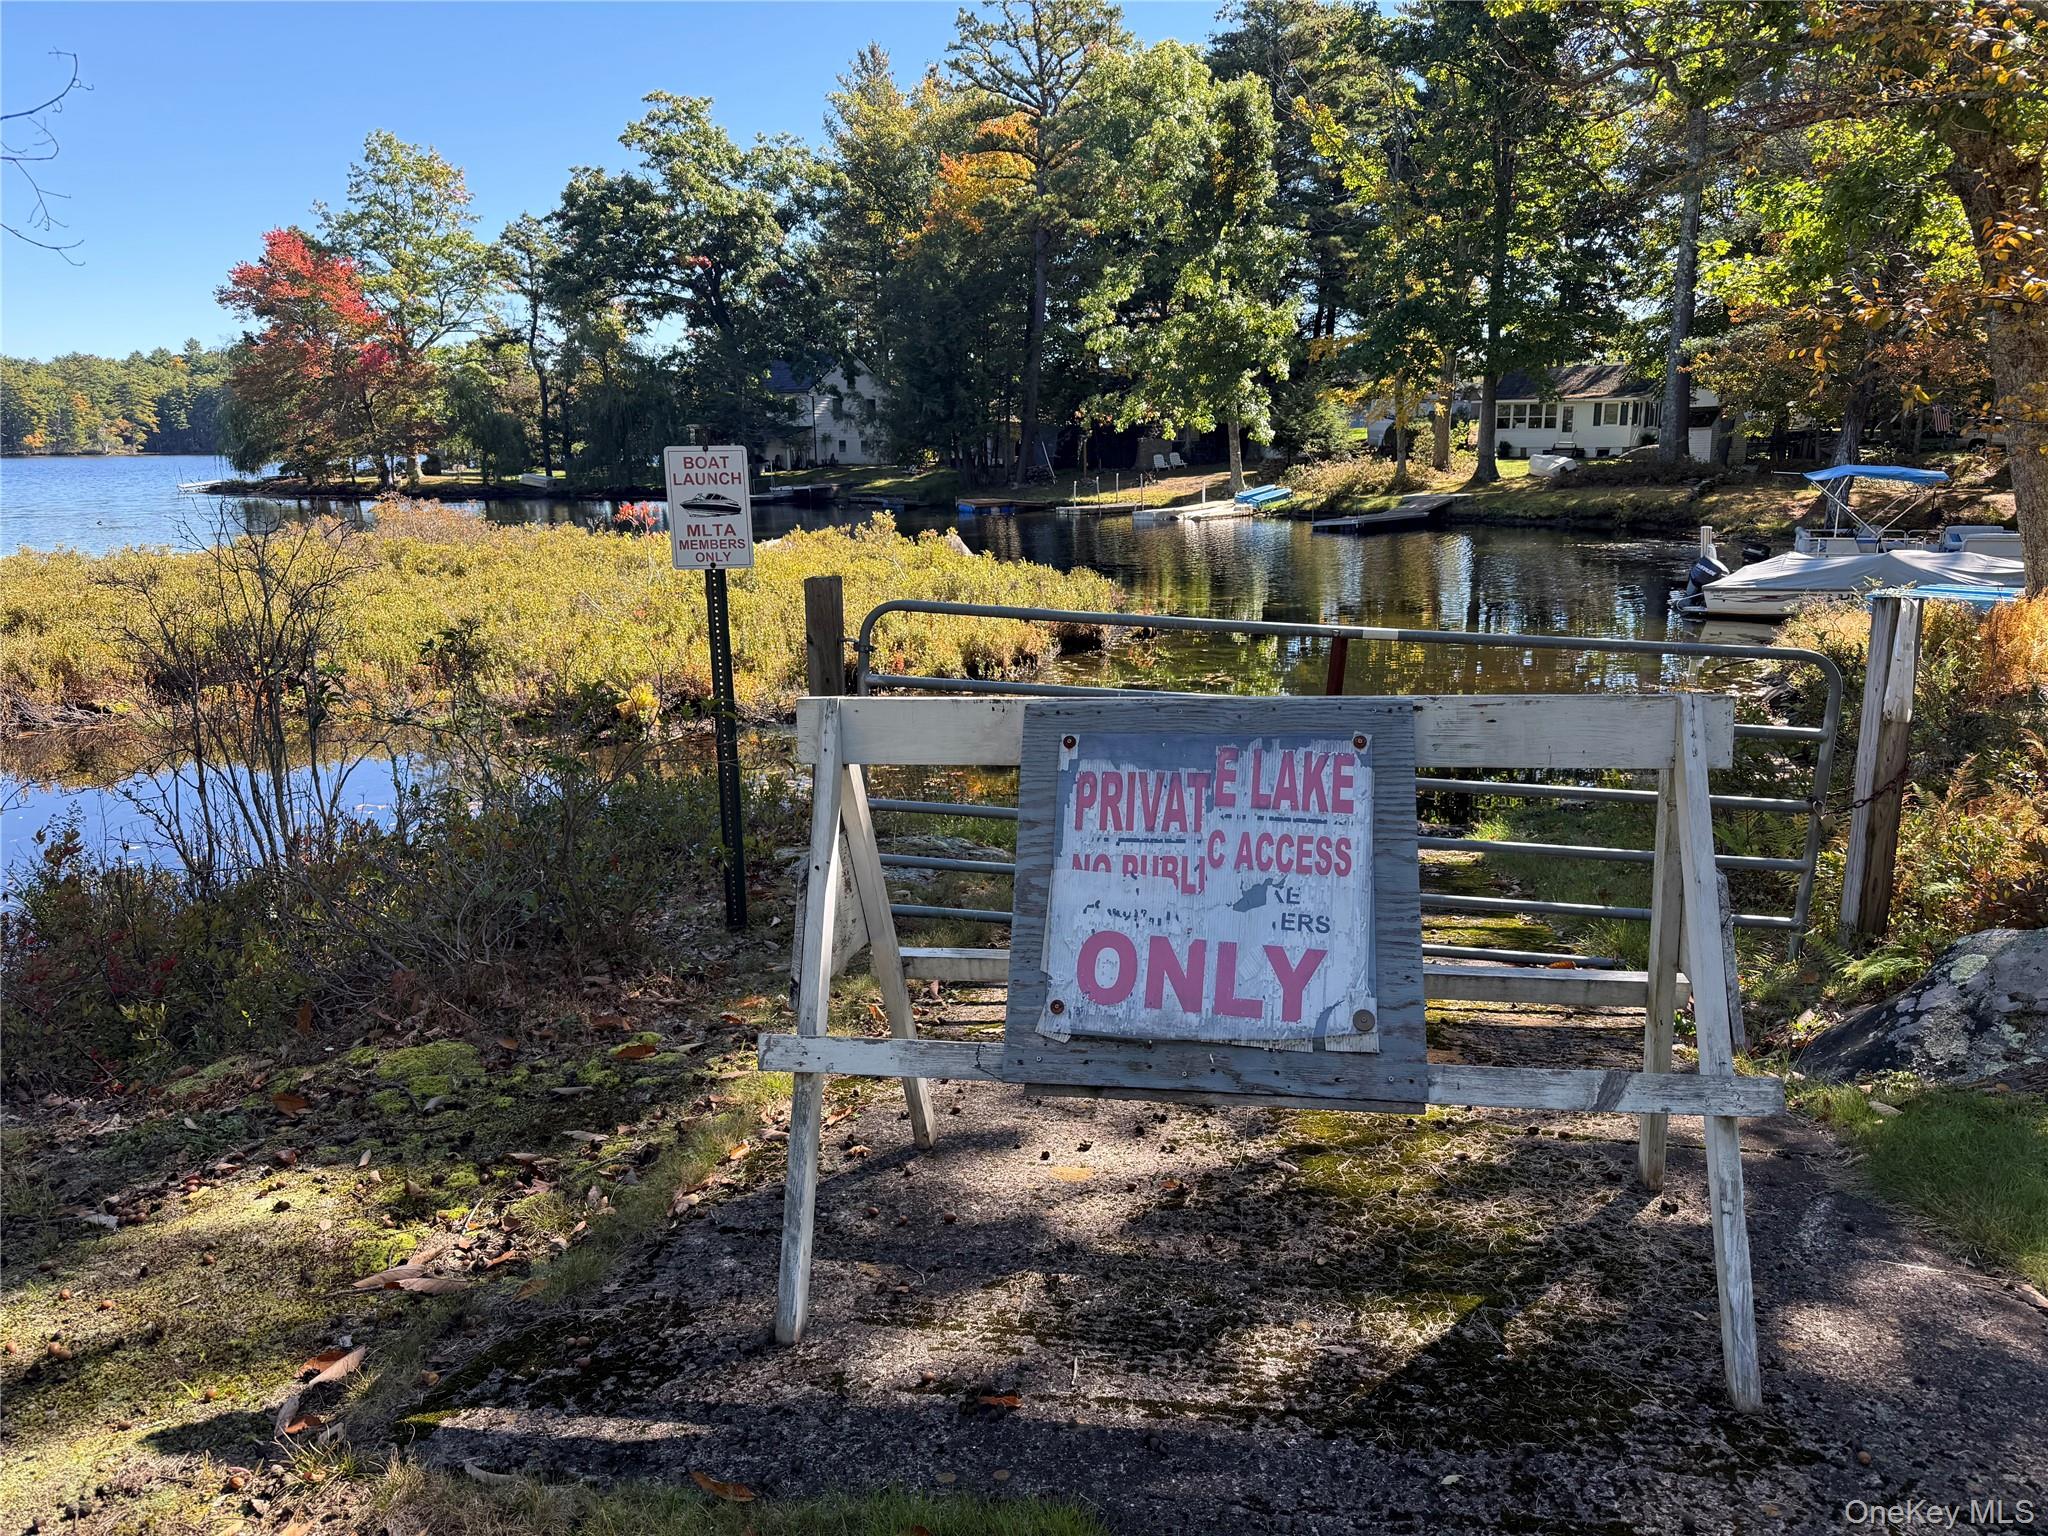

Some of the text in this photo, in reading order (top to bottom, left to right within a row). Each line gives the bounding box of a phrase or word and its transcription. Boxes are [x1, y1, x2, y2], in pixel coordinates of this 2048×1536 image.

[683, 456, 729, 469] BOAT
[673, 472, 742, 486] LAUNCH
[687, 524, 737, 537] MLTA
[680, 539, 746, 550] MEMBERS
[695, 552, 732, 562] ONLY
[1251, 748, 1356, 815] LAKE
[1234, 831, 1352, 877] ACCESS
[1076, 930, 1329, 1023] ONLY
